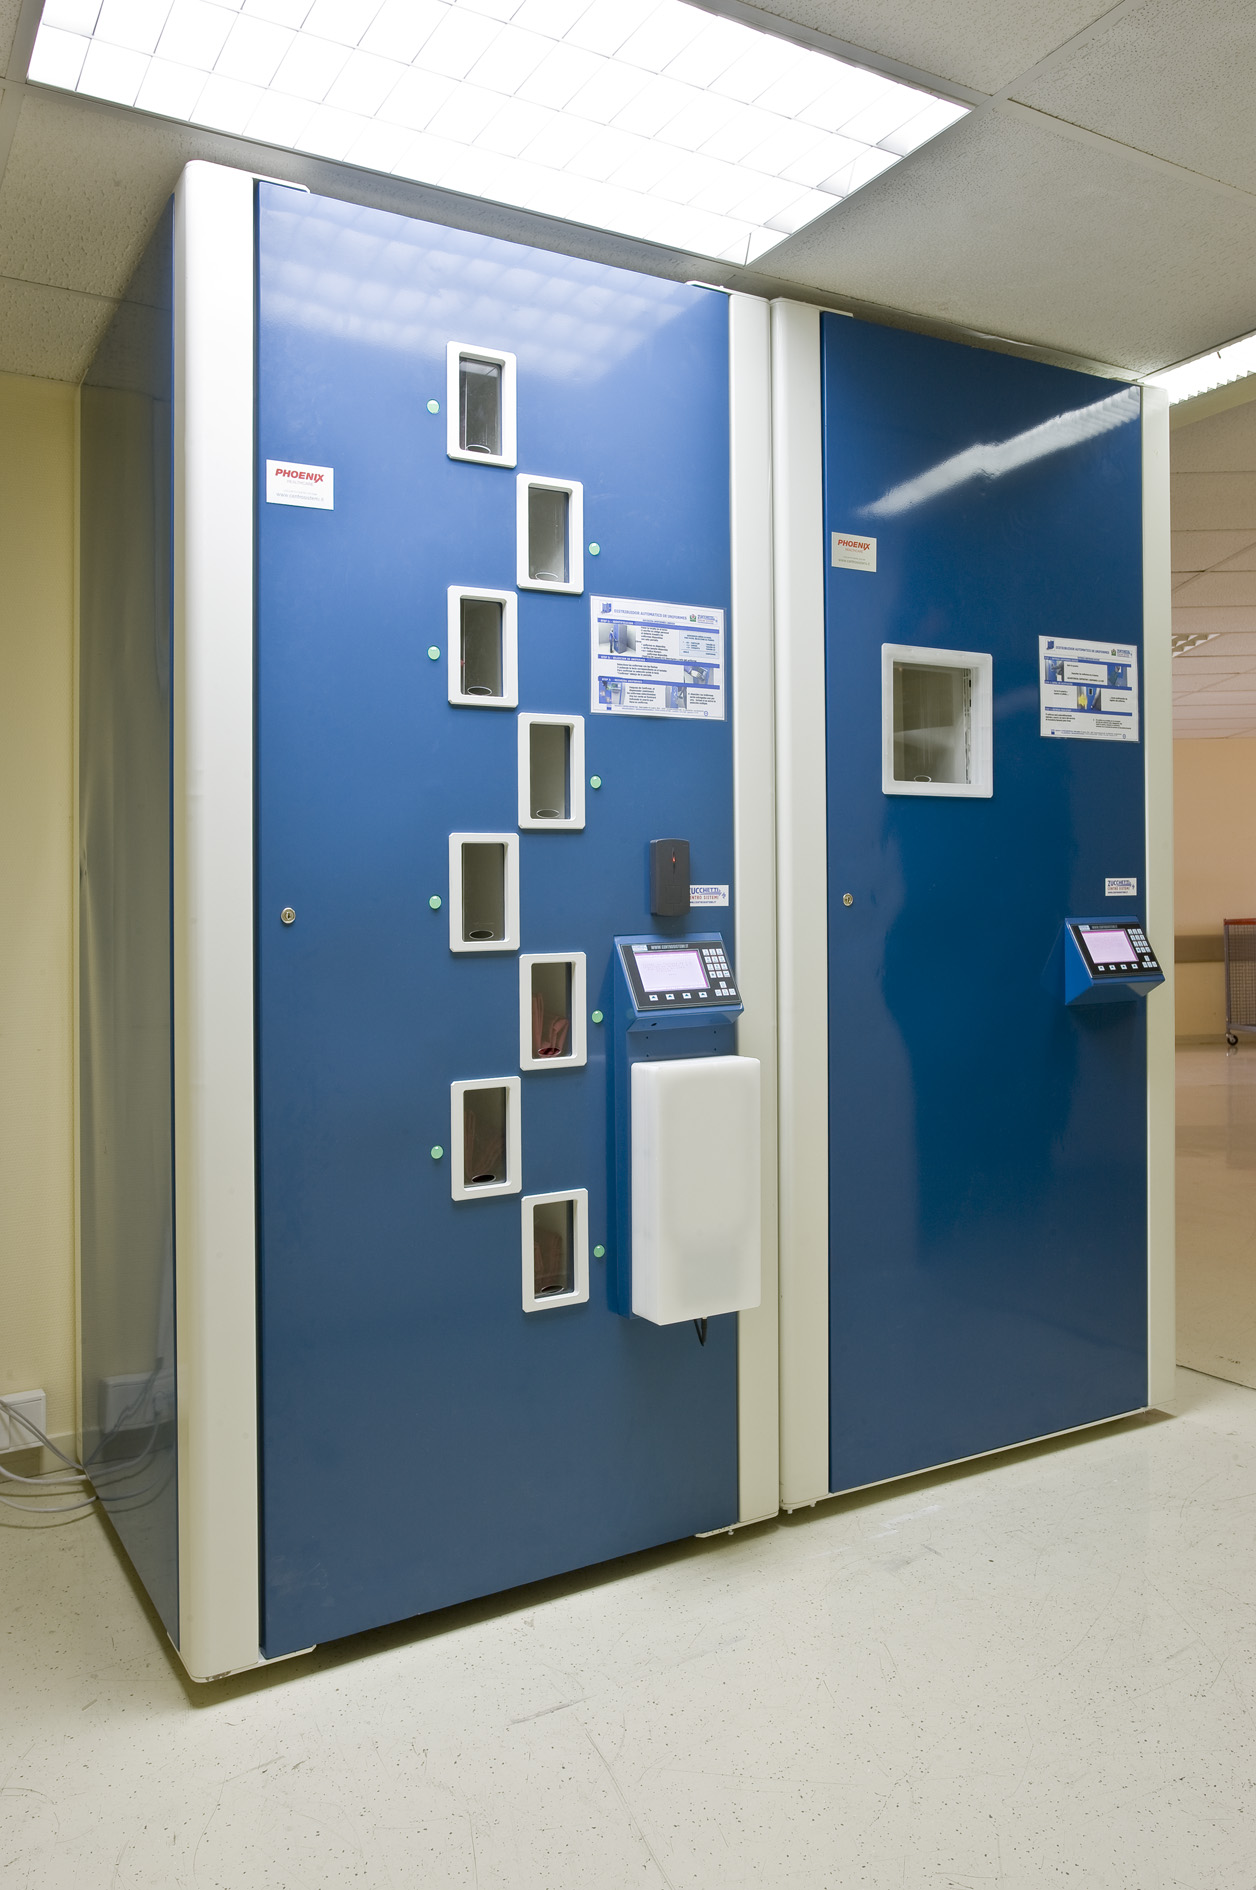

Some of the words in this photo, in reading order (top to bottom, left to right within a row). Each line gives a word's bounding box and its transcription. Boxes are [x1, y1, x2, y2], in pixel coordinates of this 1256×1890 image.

[275, 468, 324, 483] PHOENIX
[838, 539, 870, 550] PHOENIX
[690, 887, 719, 895] UCCHETTI
